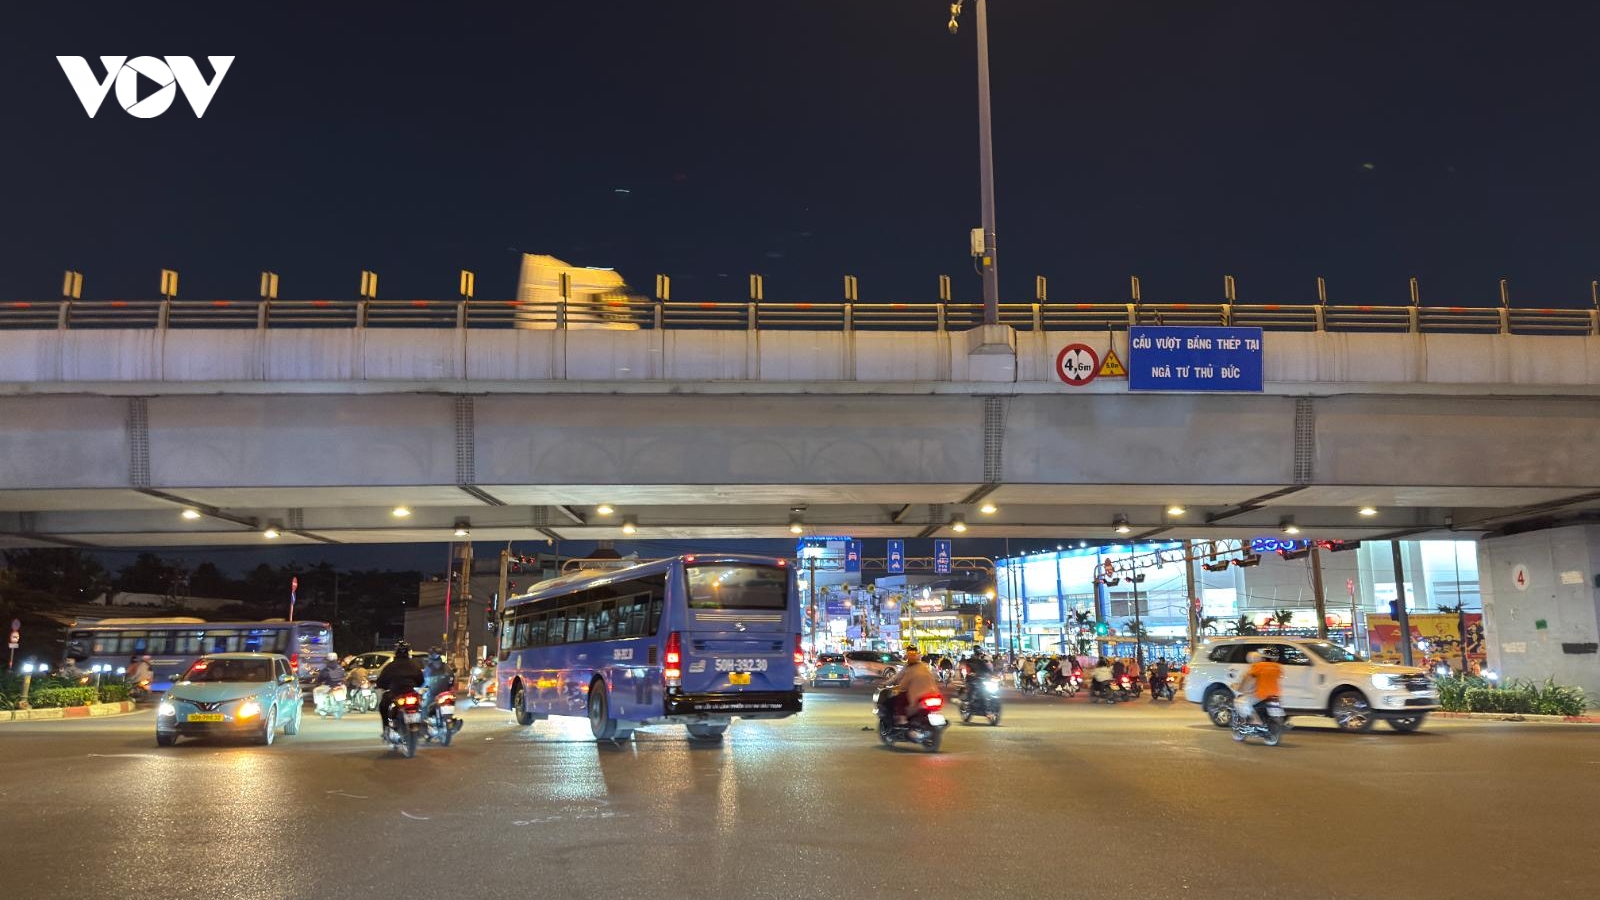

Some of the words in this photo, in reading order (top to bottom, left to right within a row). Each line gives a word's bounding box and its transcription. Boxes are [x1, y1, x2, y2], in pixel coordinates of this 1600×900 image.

[1132, 333, 1152, 349] CẦU
[1155, 336, 1182, 351] VƯỢT
[1216, 335, 1241, 350] THÉP
[1244, 339, 1260, 353] TẠI
[1064, 358, 1091, 374] 4,6m
[1151, 364, 1171, 378] NGÃ
[1175, 365, 1190, 378] TƯ
[1194, 363, 1214, 379] THỦ
[1221, 363, 1241, 379] ĐỨC
[1517, 569, 1525, 586] 4
[714, 658, 768, 672] 50H-392.30
